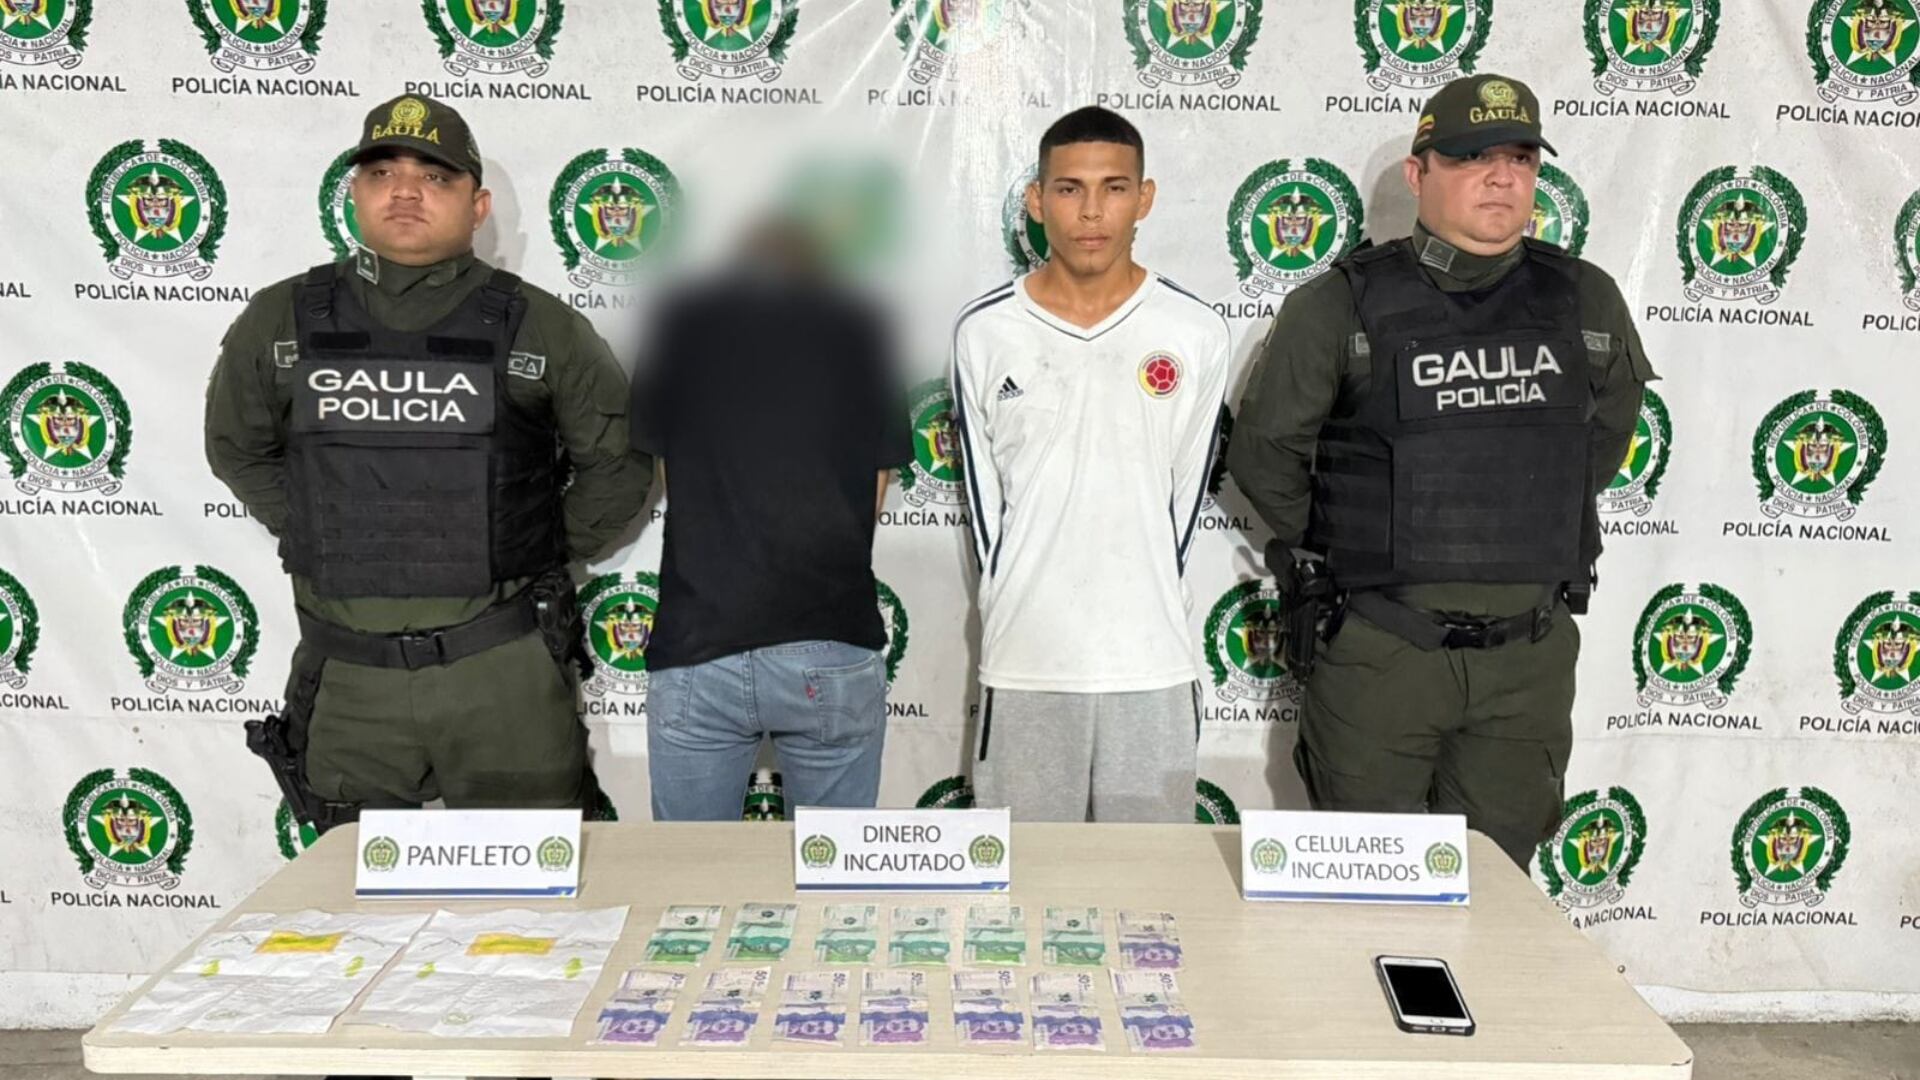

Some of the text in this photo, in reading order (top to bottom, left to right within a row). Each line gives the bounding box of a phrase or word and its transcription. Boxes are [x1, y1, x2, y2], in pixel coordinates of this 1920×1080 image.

[31, 19, 72, 48] NACIONAL
[264, 23, 305, 52] NACIONAL
[498, 27, 541, 56] NACIONAL
[35, 47, 69, 62] PATRIA
[731, 31, 775, 60] NACIONAL
[1192, 39, 1236, 68] NACIONAL
[223, 50, 246, 64] DIOS
[268, 52, 303, 66] PATRIA
[456, 54, 479, 68] DIOS
[502, 56, 536, 70] PATRIA
[689, 58, 712, 73] DIOS
[735, 60, 769, 74] PATRIA
[1421, 43, 1466, 71] NACIONAL
[22, 74, 126, 92] NACIONAL
[1150, 66, 1172, 80] DIOS
[1194, 67, 1229, 81] PATRIA
[1380, 69, 1402, 83] DIOS
[1423, 70, 1457, 84] PATRIA
[1607, 73, 1629, 87] DIOS
[1650, 74, 1683, 88] PATRIA
[172, 75, 360, 96] POLICÍA NACIONAL
[406, 79, 591, 100] POLICÍA NACIONAL
[637, 83, 821, 104] POLICÍA NACIONAL
[1828, 81, 1850, 95] DIOS
[1871, 84, 1907, 97] PATRIA
[1096, 90, 1280, 111] POLICÍA NACIONAL
[1326, 93, 1402, 112] POLICÍA
[1554, 97, 1730, 118] POLICÍA NACIONAL
[1470, 107, 1532, 124] GAULA
[1776, 105, 1920, 127] POLICÍA NACIO
[371, 125, 441, 145] GAULA
[609, 162, 622, 170] DE
[1290, 173, 1304, 181] DE
[1737, 179, 1750, 187] DE
[162, 233, 204, 260] NACIONAL
[121, 258, 143, 272] DIOS
[166, 260, 200, 273] PATRIA
[581, 267, 602, 280] DIOS
[1293, 250, 1337, 278] NACIONAL
[1734, 258, 1777, 284] NACIONAL
[75, 281, 250, 302] POLICÍA NACIONAL
[1252, 277, 1274, 290] DIOS
[1695, 281, 1715, 295] DIOS
[1735, 284, 1768, 297] PATRIA
[1212, 302, 1275, 319] OLICÍA
[1647, 304, 1814, 326] POLICÍA NACIONAL
[1862, 315, 1920, 331] POLIC
[1412, 345, 1563, 387] GAULA
[308, 369, 479, 395] GAULA
[1437, 378, 1547, 411] POLICÍA
[319, 397, 466, 422] POLICIA
[62, 500, 163, 516] NACIONAL
[205, 503, 247, 517] POLI
[879, 508, 938, 526] OLICÍA
[1199, 516, 1253, 531] IONAL
[1723, 520, 1891, 541] POLICÍA NACIONAL
[0, 694, 69, 709] CIONAL
[111, 695, 283, 714] POLICÍA NACIONAL
[1205, 704, 1298, 722] LICÍA NACI
[1607, 709, 1762, 730] POLICÍA NACIONAL
[1800, 716, 1920, 734] POLICÍA NACI
[863, 825, 941, 844] DINERO
[1295, 836, 1404, 856] CELULARES
[407, 845, 532, 867] PANFLETO
[844, 854, 965, 872] INCAUTADO
[1292, 862, 1420, 883] INCAUTADOS
[51, 891, 221, 908] POLICÍA NACIONAL
[1584, 906, 1657, 928] NACIONAL
[1700, 909, 1857, 926] POLICÍA NACIONAL
